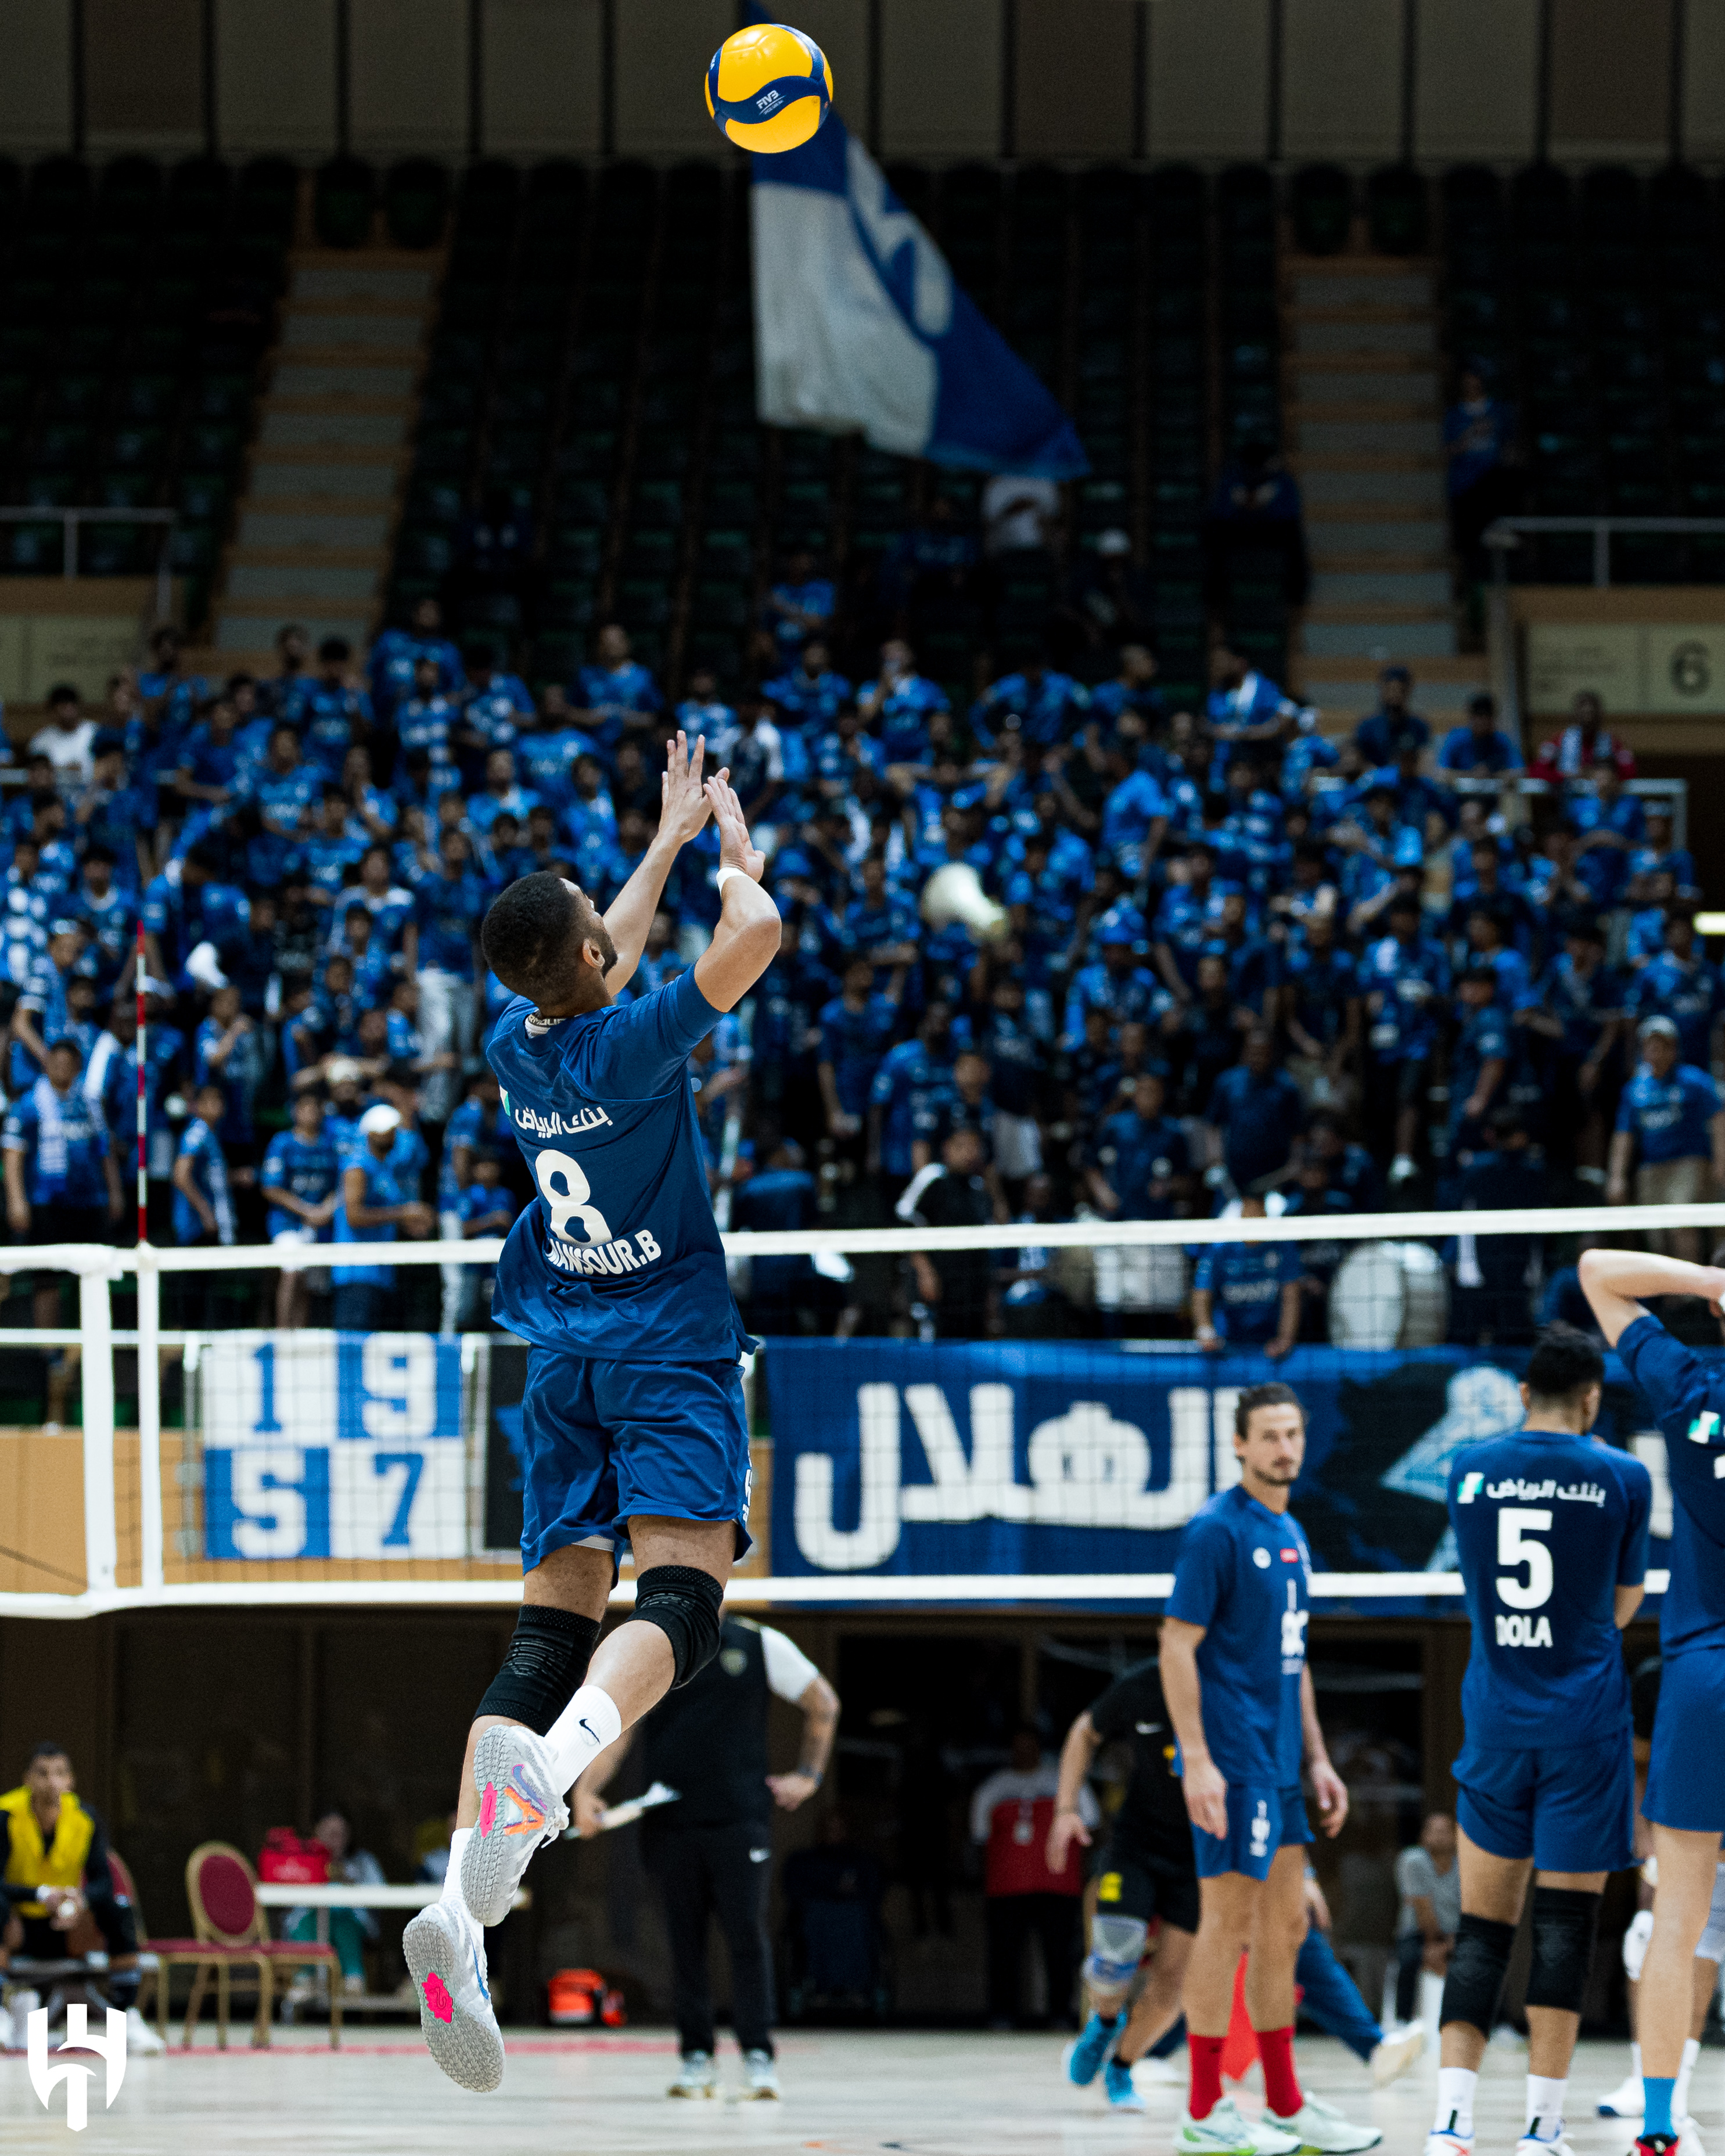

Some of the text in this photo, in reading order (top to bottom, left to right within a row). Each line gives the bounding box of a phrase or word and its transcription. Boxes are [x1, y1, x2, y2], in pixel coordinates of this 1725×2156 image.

[1669, 640, 1710, 696] 6
[515, 1100, 613, 1138] بنك الرياض
[535, 1149, 613, 1249] 8
[1495, 1507, 1554, 1610] 5
